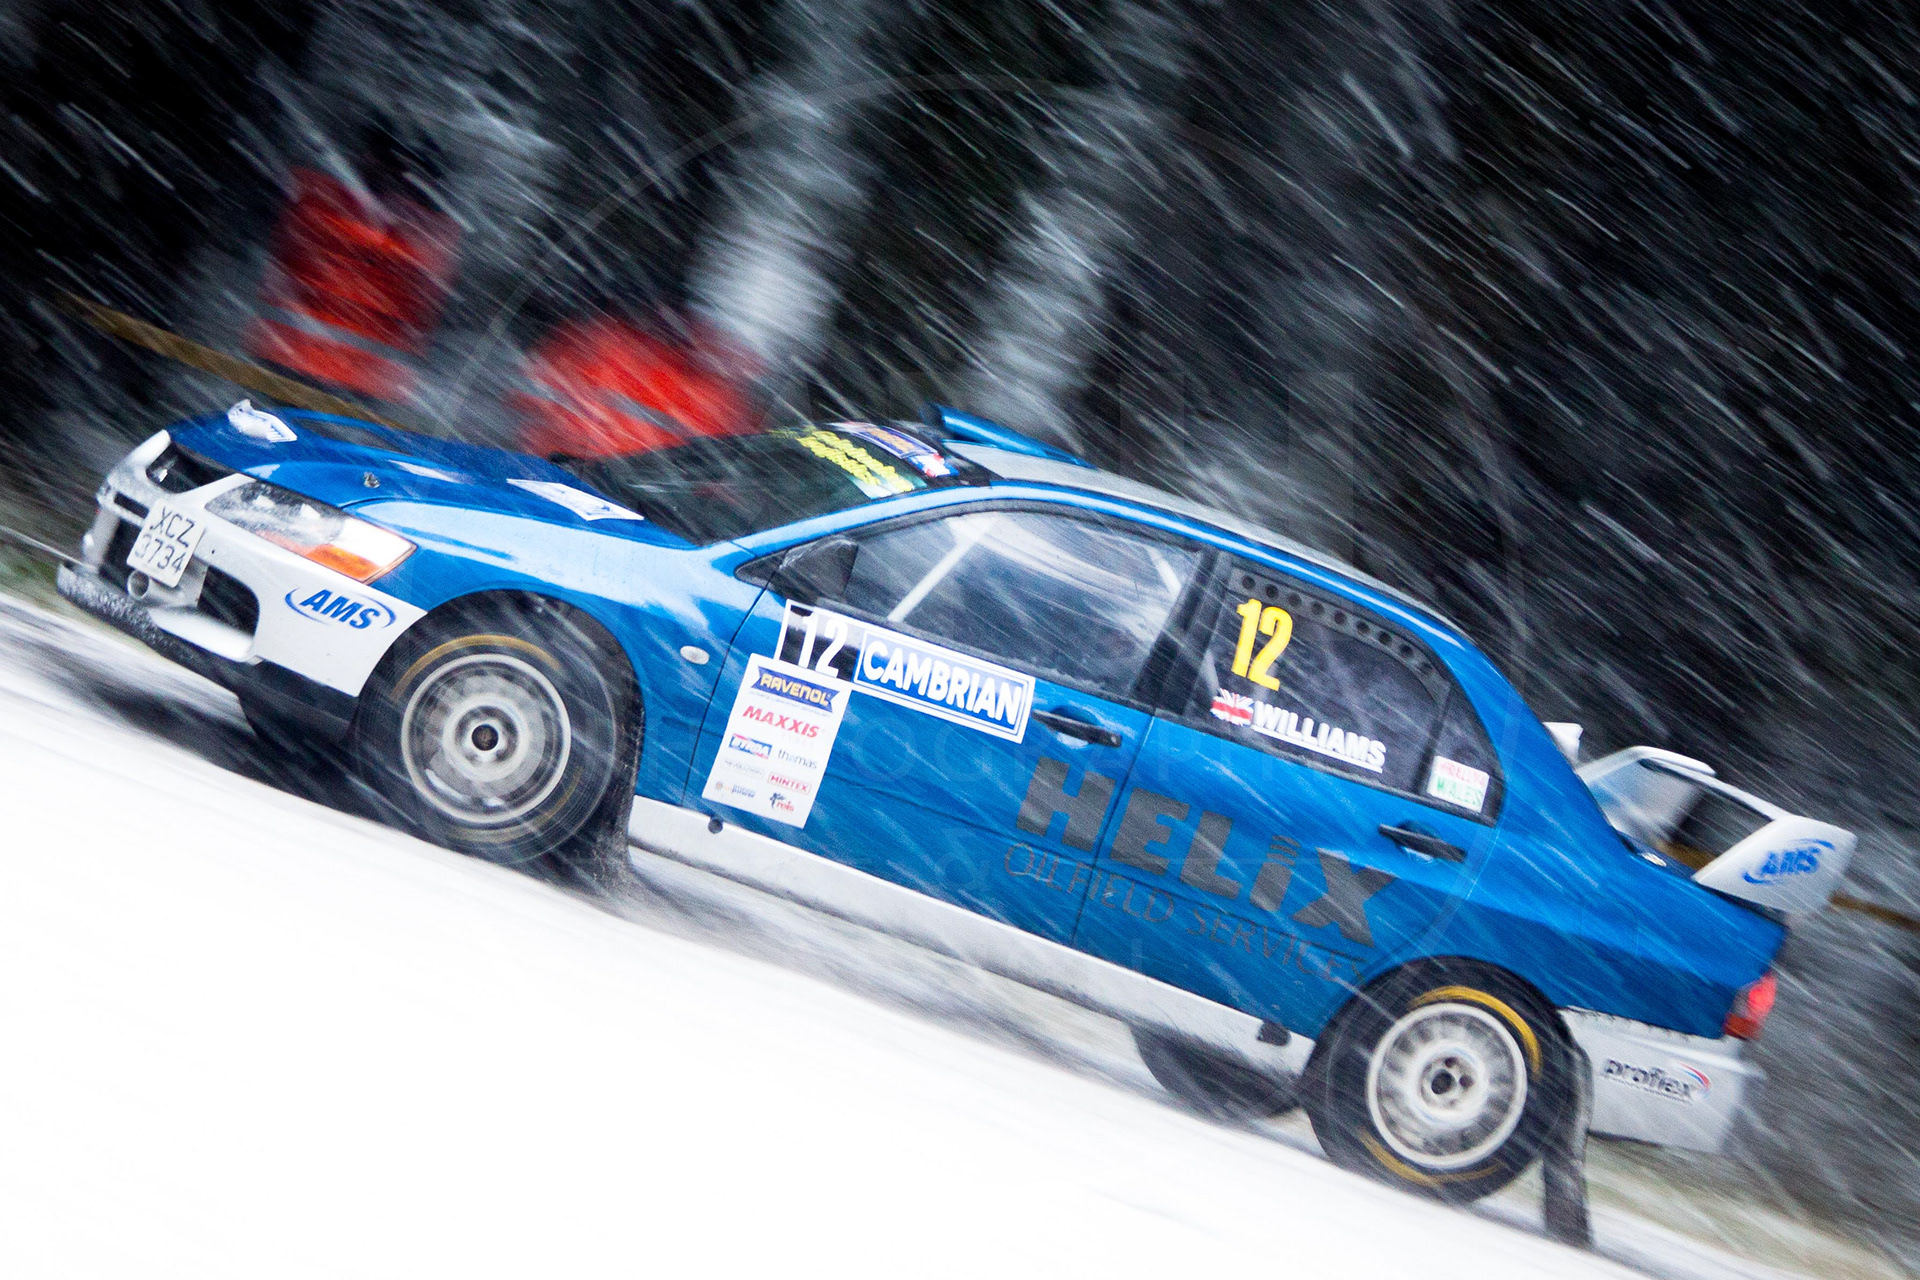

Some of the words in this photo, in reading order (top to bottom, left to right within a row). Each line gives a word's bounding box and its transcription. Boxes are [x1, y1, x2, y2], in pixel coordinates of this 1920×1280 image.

[149, 505, 196, 548] XCZ
[135, 533, 187, 574] 3734
[299, 588, 381, 630] AMS
[798, 611, 849, 678] 12
[1231, 598, 1293, 691] 12
[759, 673, 830, 707] RAVENOL
[862, 641, 1023, 726] CAMBRIAN
[742, 704, 820, 739] MAXXIS
[1252, 700, 1387, 768] WILLIAMS
[770, 774, 810, 793] MINTEX
[1759, 846, 1822, 876] AMS
[1004, 842, 1175, 922] OILFIELD
[1187, 904, 1367, 985] SERVICES
